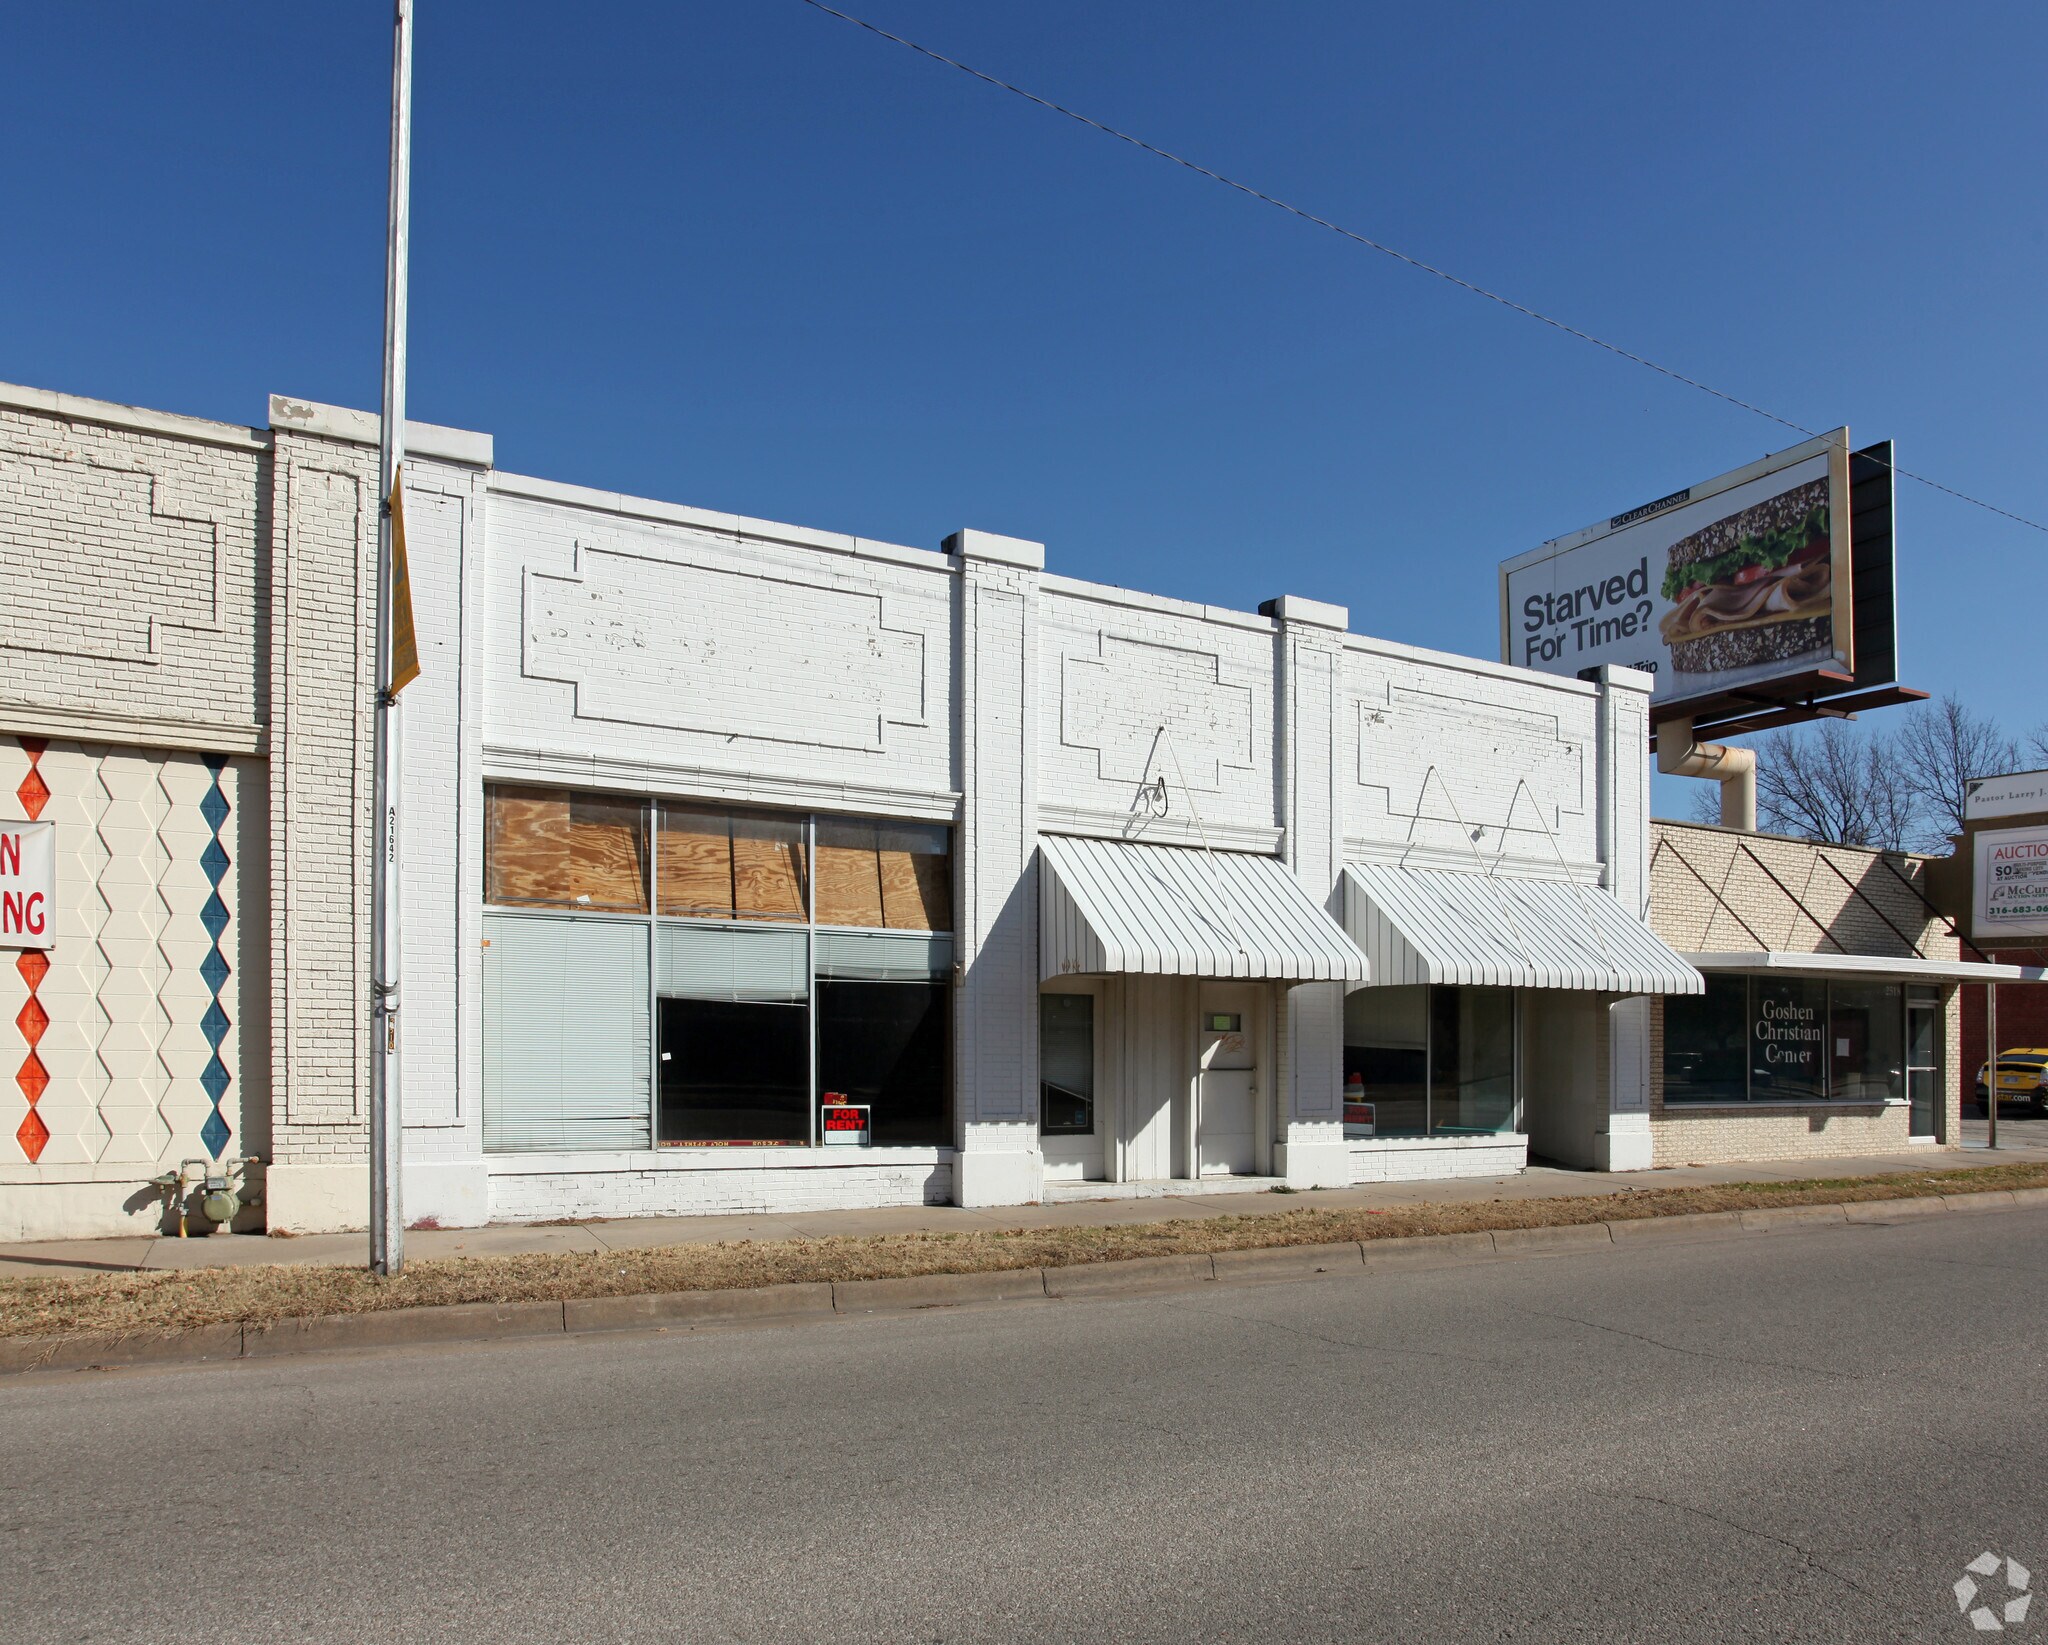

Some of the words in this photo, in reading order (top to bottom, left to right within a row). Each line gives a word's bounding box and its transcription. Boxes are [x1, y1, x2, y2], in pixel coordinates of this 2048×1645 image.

[1523, 556, 1649, 633] Starved
[1525, 633, 1566, 667] For
[1570, 599, 1653, 652] Time?
[1975, 795, 2005, 803] Pastor
[2009, 791, 2035, 799] Larry
[388, 806, 396, 863] A21642
[1994, 843, 2048, 860] AUCTIO
[2007, 884, 2048, 896] McCur
[1989, 904, 2048, 915] 316-683-06
[1762, 999, 1814, 1020] Goshen
[1755, 1020, 1821, 1041] Christian
[833, 1109, 859, 1119] FOR
[826, 1120, 865, 1131] RENT
